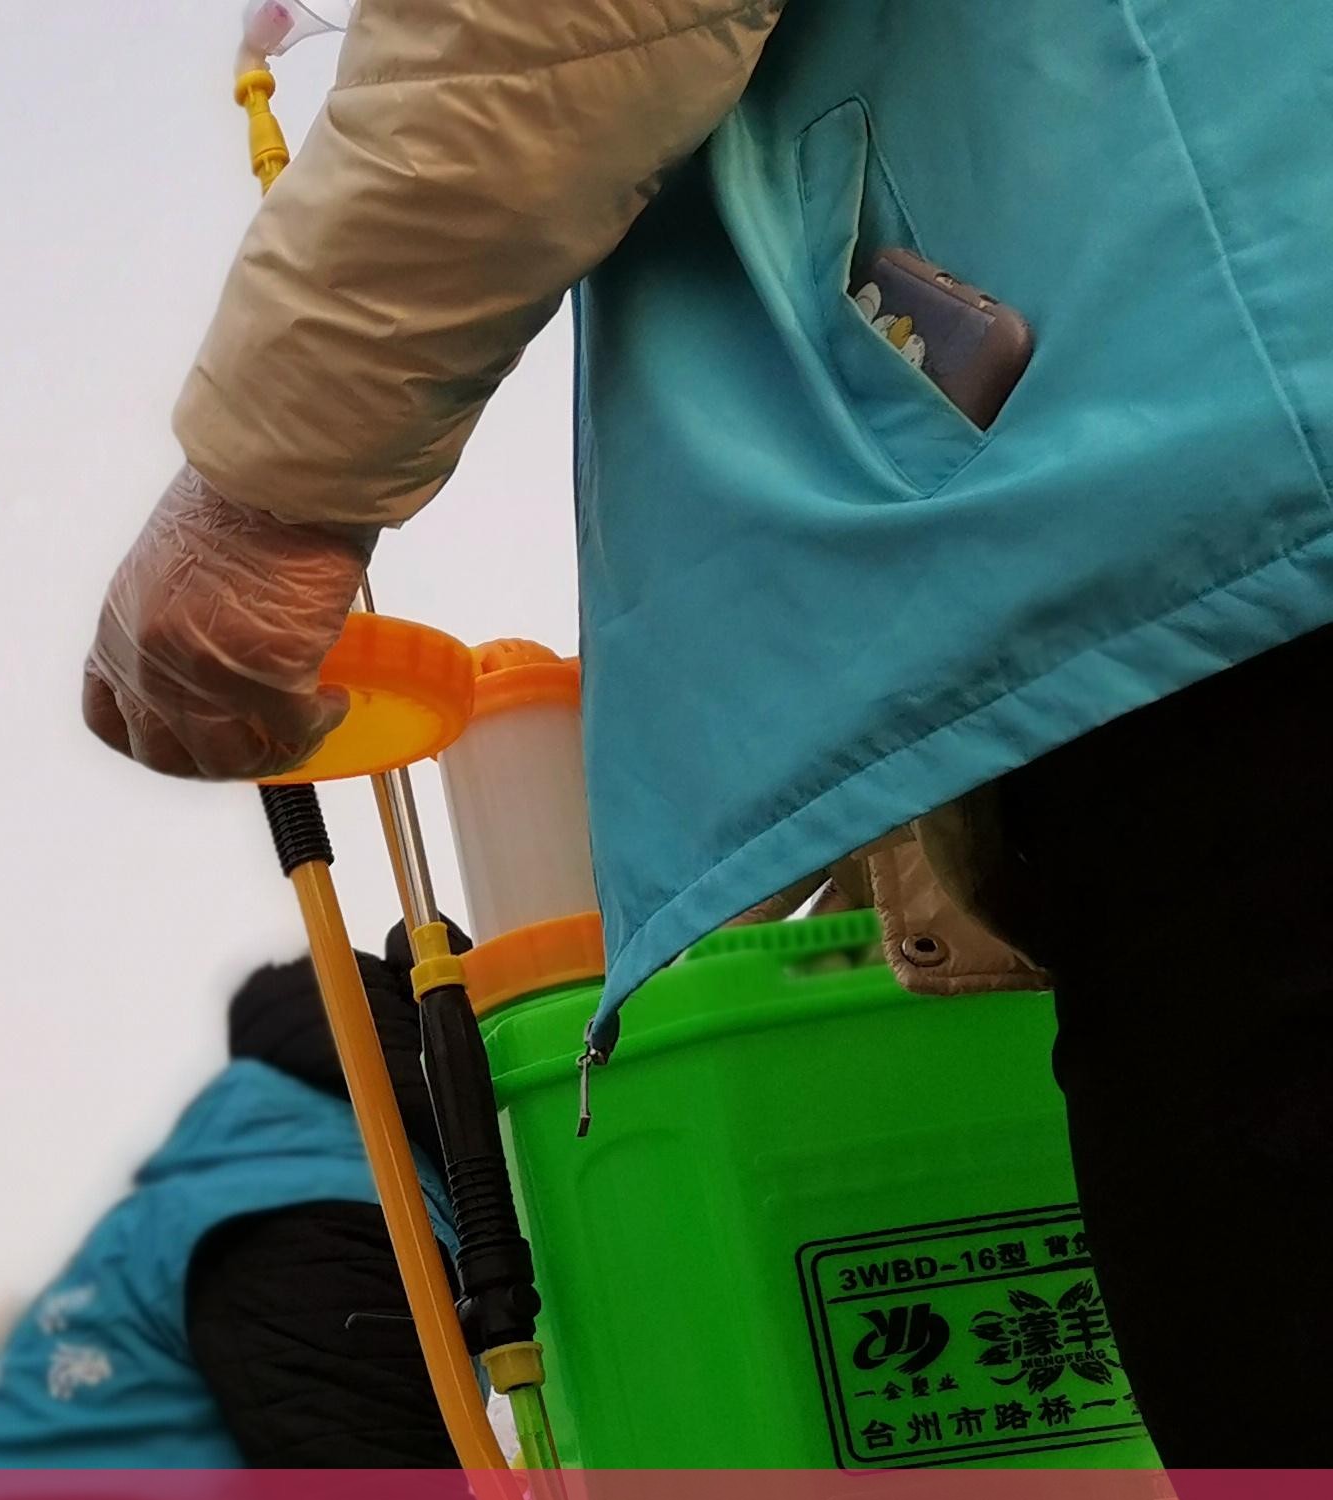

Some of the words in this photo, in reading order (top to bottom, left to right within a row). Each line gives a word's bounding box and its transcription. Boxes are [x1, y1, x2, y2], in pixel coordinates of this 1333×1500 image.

[837, 1241, 1030, 1291] 3WBD-16型
[859, 1393, 1141, 1450] 台州市路桥一
